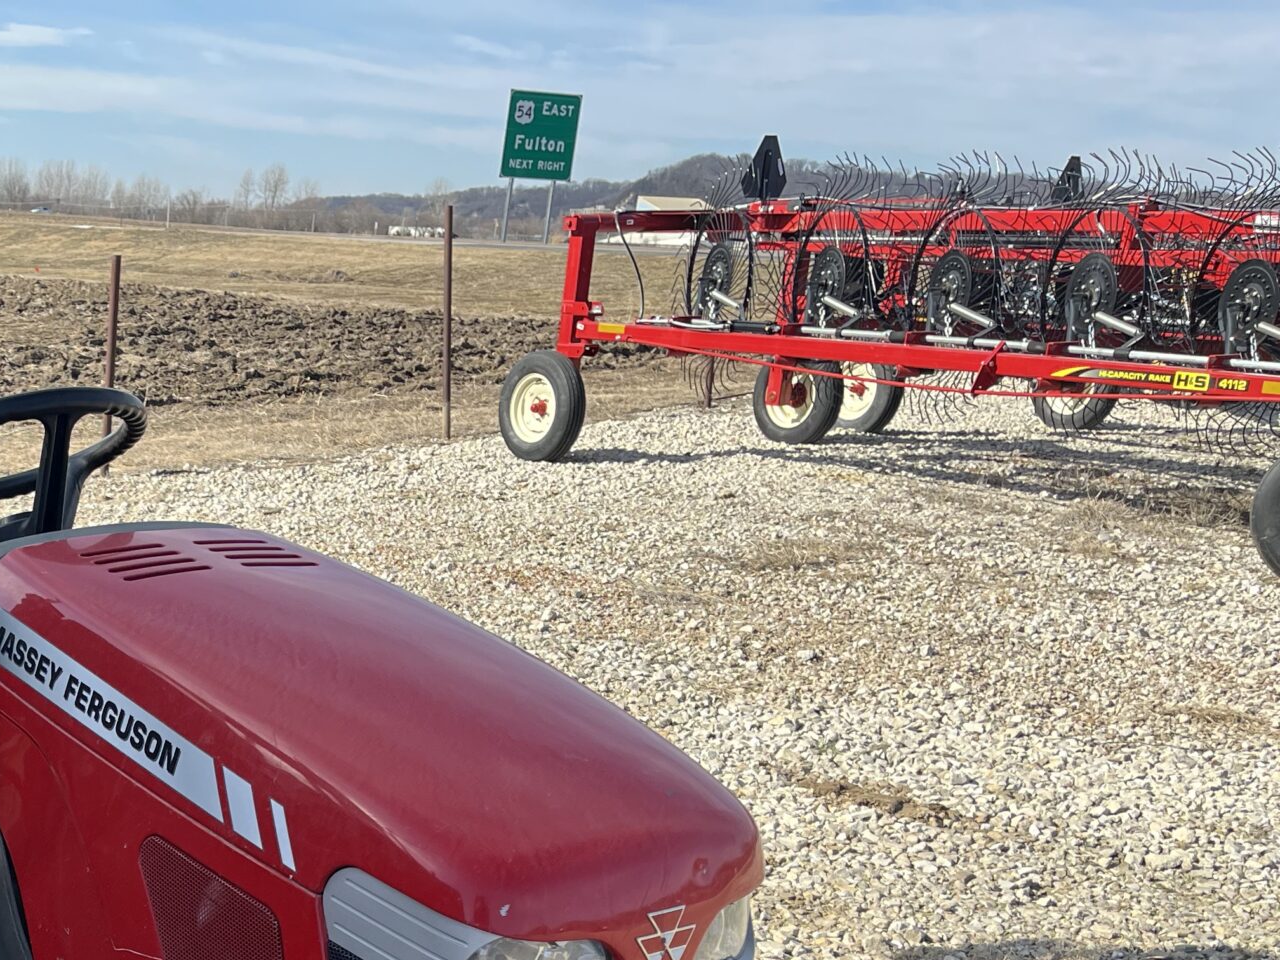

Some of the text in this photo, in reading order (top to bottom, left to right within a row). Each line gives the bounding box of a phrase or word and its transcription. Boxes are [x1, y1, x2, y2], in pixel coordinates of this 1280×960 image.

[516, 105, 532, 119] 54
[514, 134, 565, 152] Fulton
[509, 158, 565, 171] NEXT RIGHT
[1098, 369, 1147, 381] HI-CAPACITY
[1148, 373, 1171, 383] RAKE
[1218, 378, 1247, 390] 4112
[64, 674, 181, 775] FERGUSON
